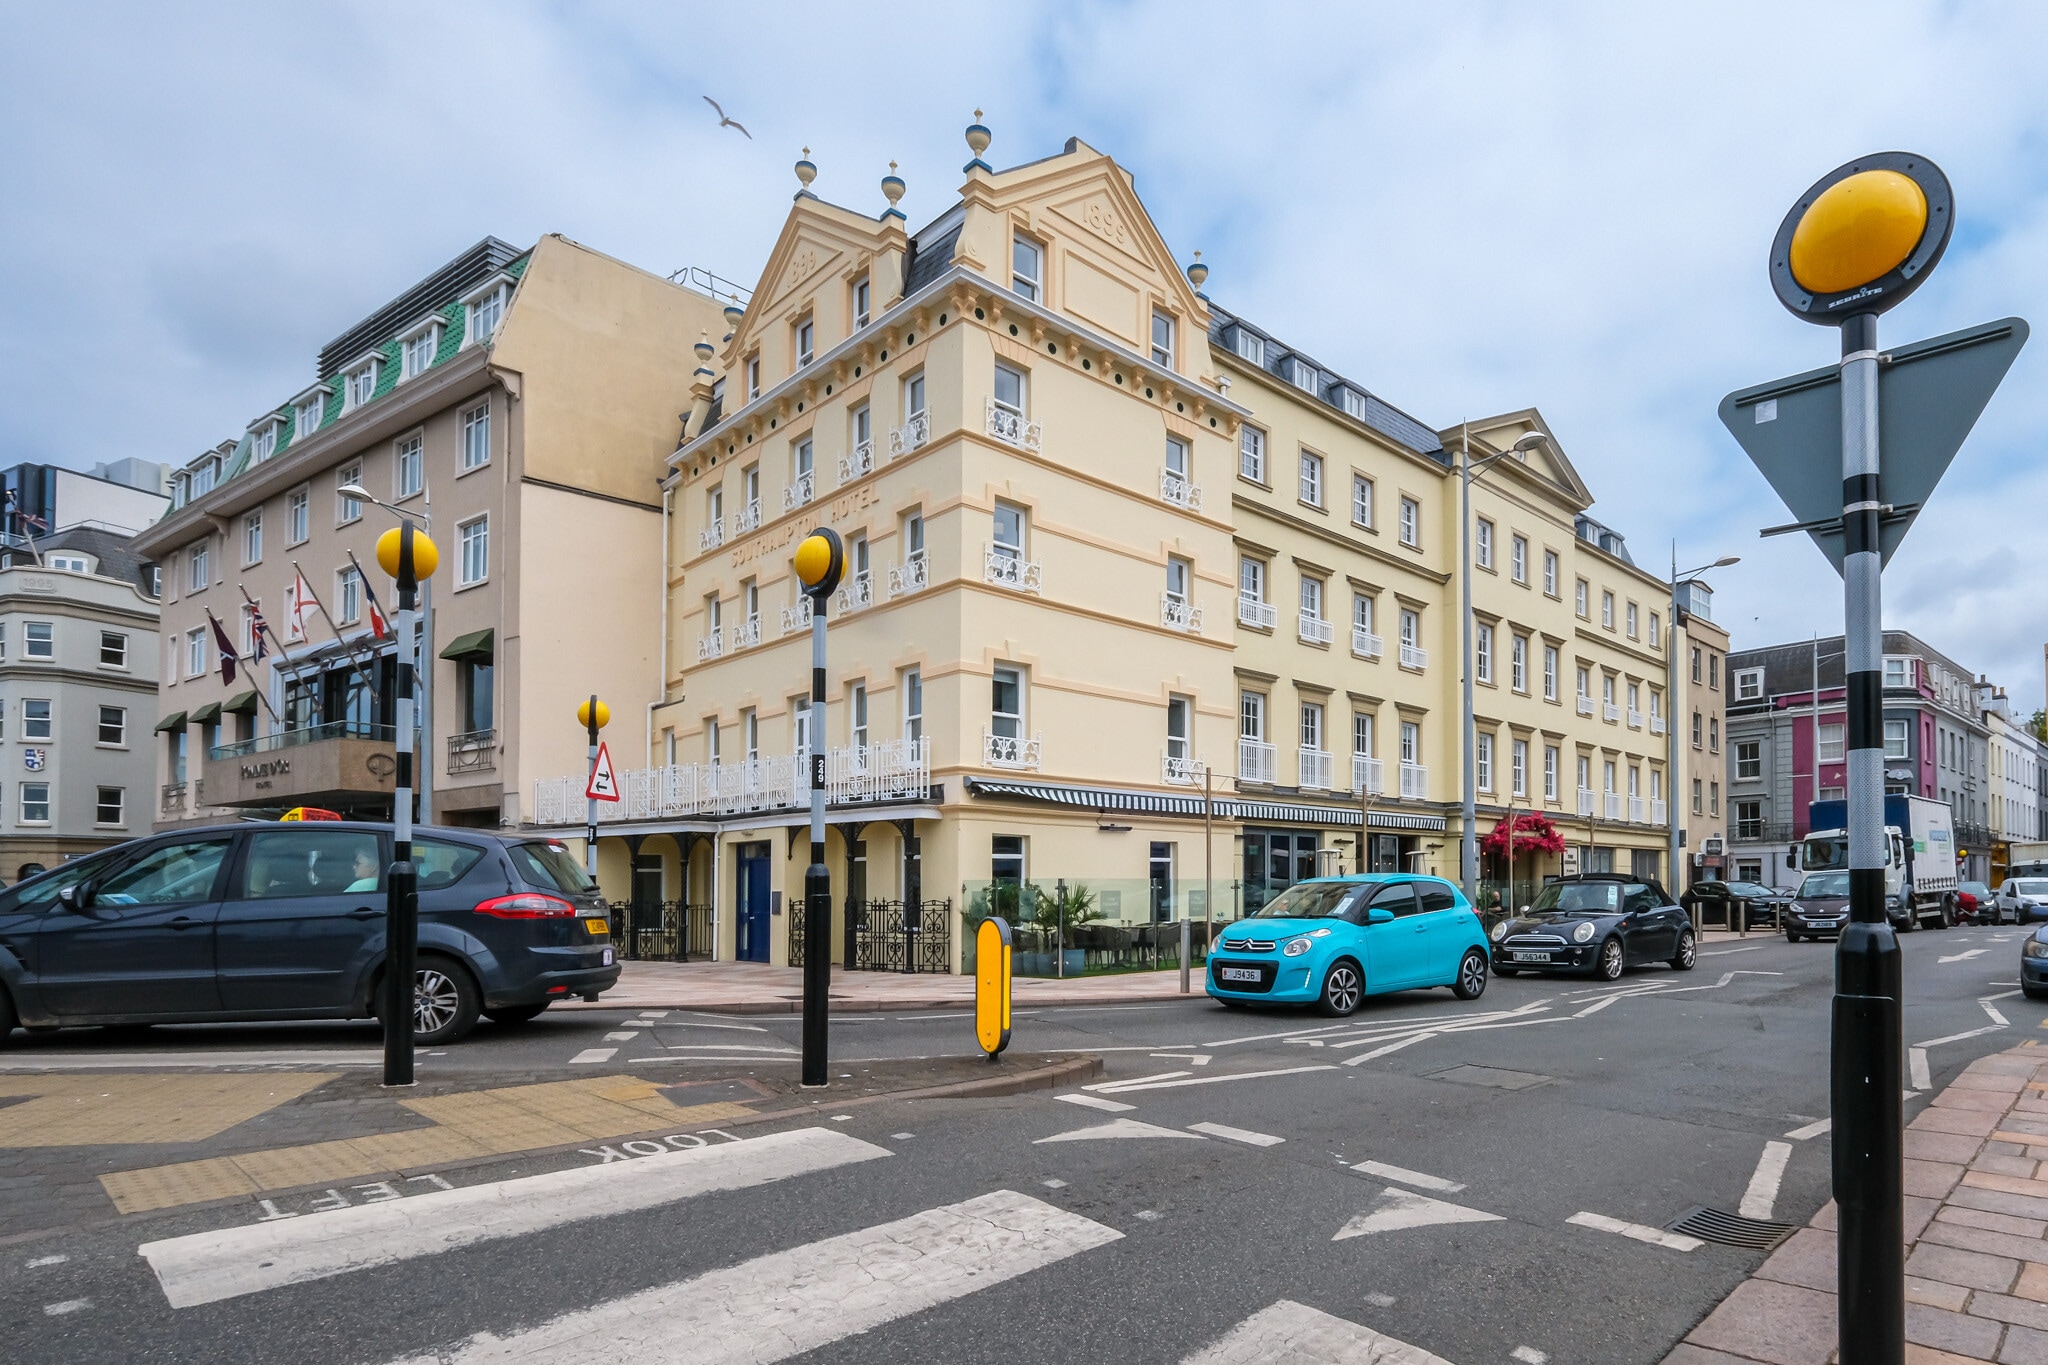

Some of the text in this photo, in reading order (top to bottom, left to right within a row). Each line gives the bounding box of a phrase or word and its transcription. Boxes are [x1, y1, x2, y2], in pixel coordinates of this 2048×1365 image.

[1828, 287, 1883, 309] ZEBRITE
[731, 483, 880, 568] SOUTHAMPTON HOTEL
[817, 759, 825, 783] 249
[1233, 969, 1255, 980] J9436
[256, 1128, 743, 1222] LOOK LEFT
